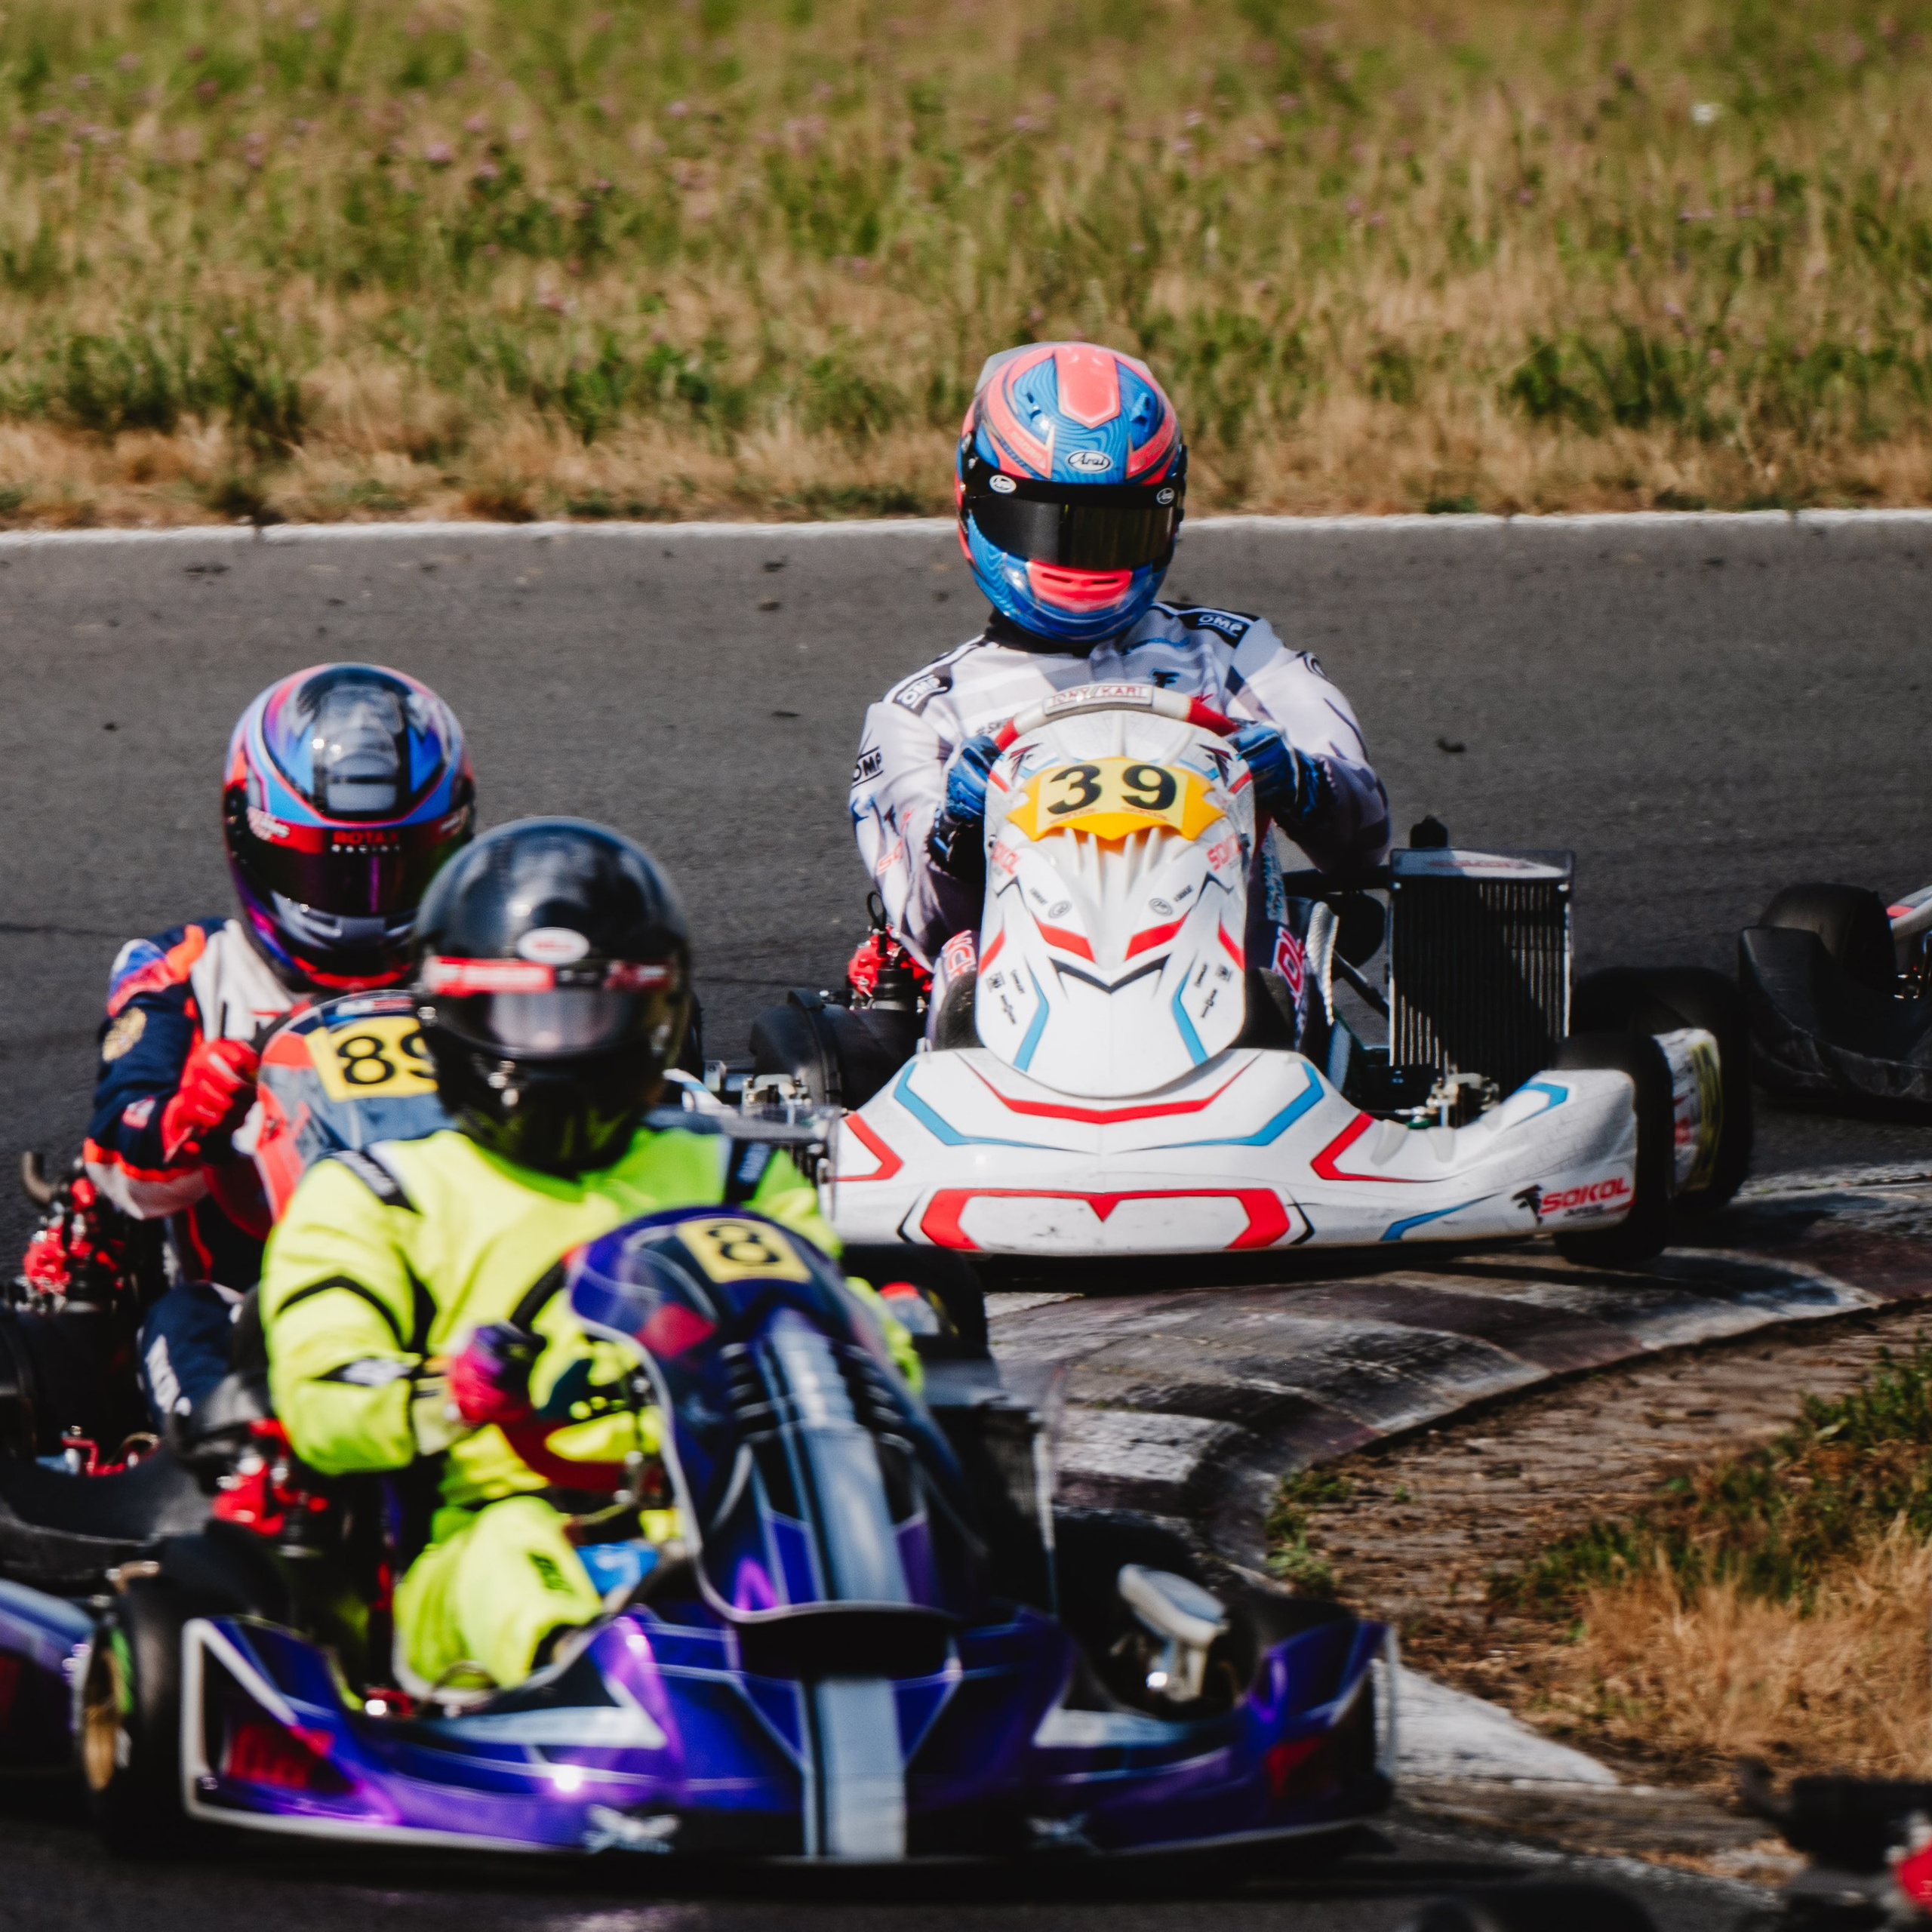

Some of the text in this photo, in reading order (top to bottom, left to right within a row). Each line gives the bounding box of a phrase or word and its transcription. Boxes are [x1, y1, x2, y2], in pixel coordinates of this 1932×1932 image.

[1072, 451, 1109, 469] Arai
[1198, 614, 1244, 632] OMP
[901, 676, 941, 705] OMP
[1047, 764, 1177, 815] 39
[1539, 1177, 1631, 1215] SOKOL
